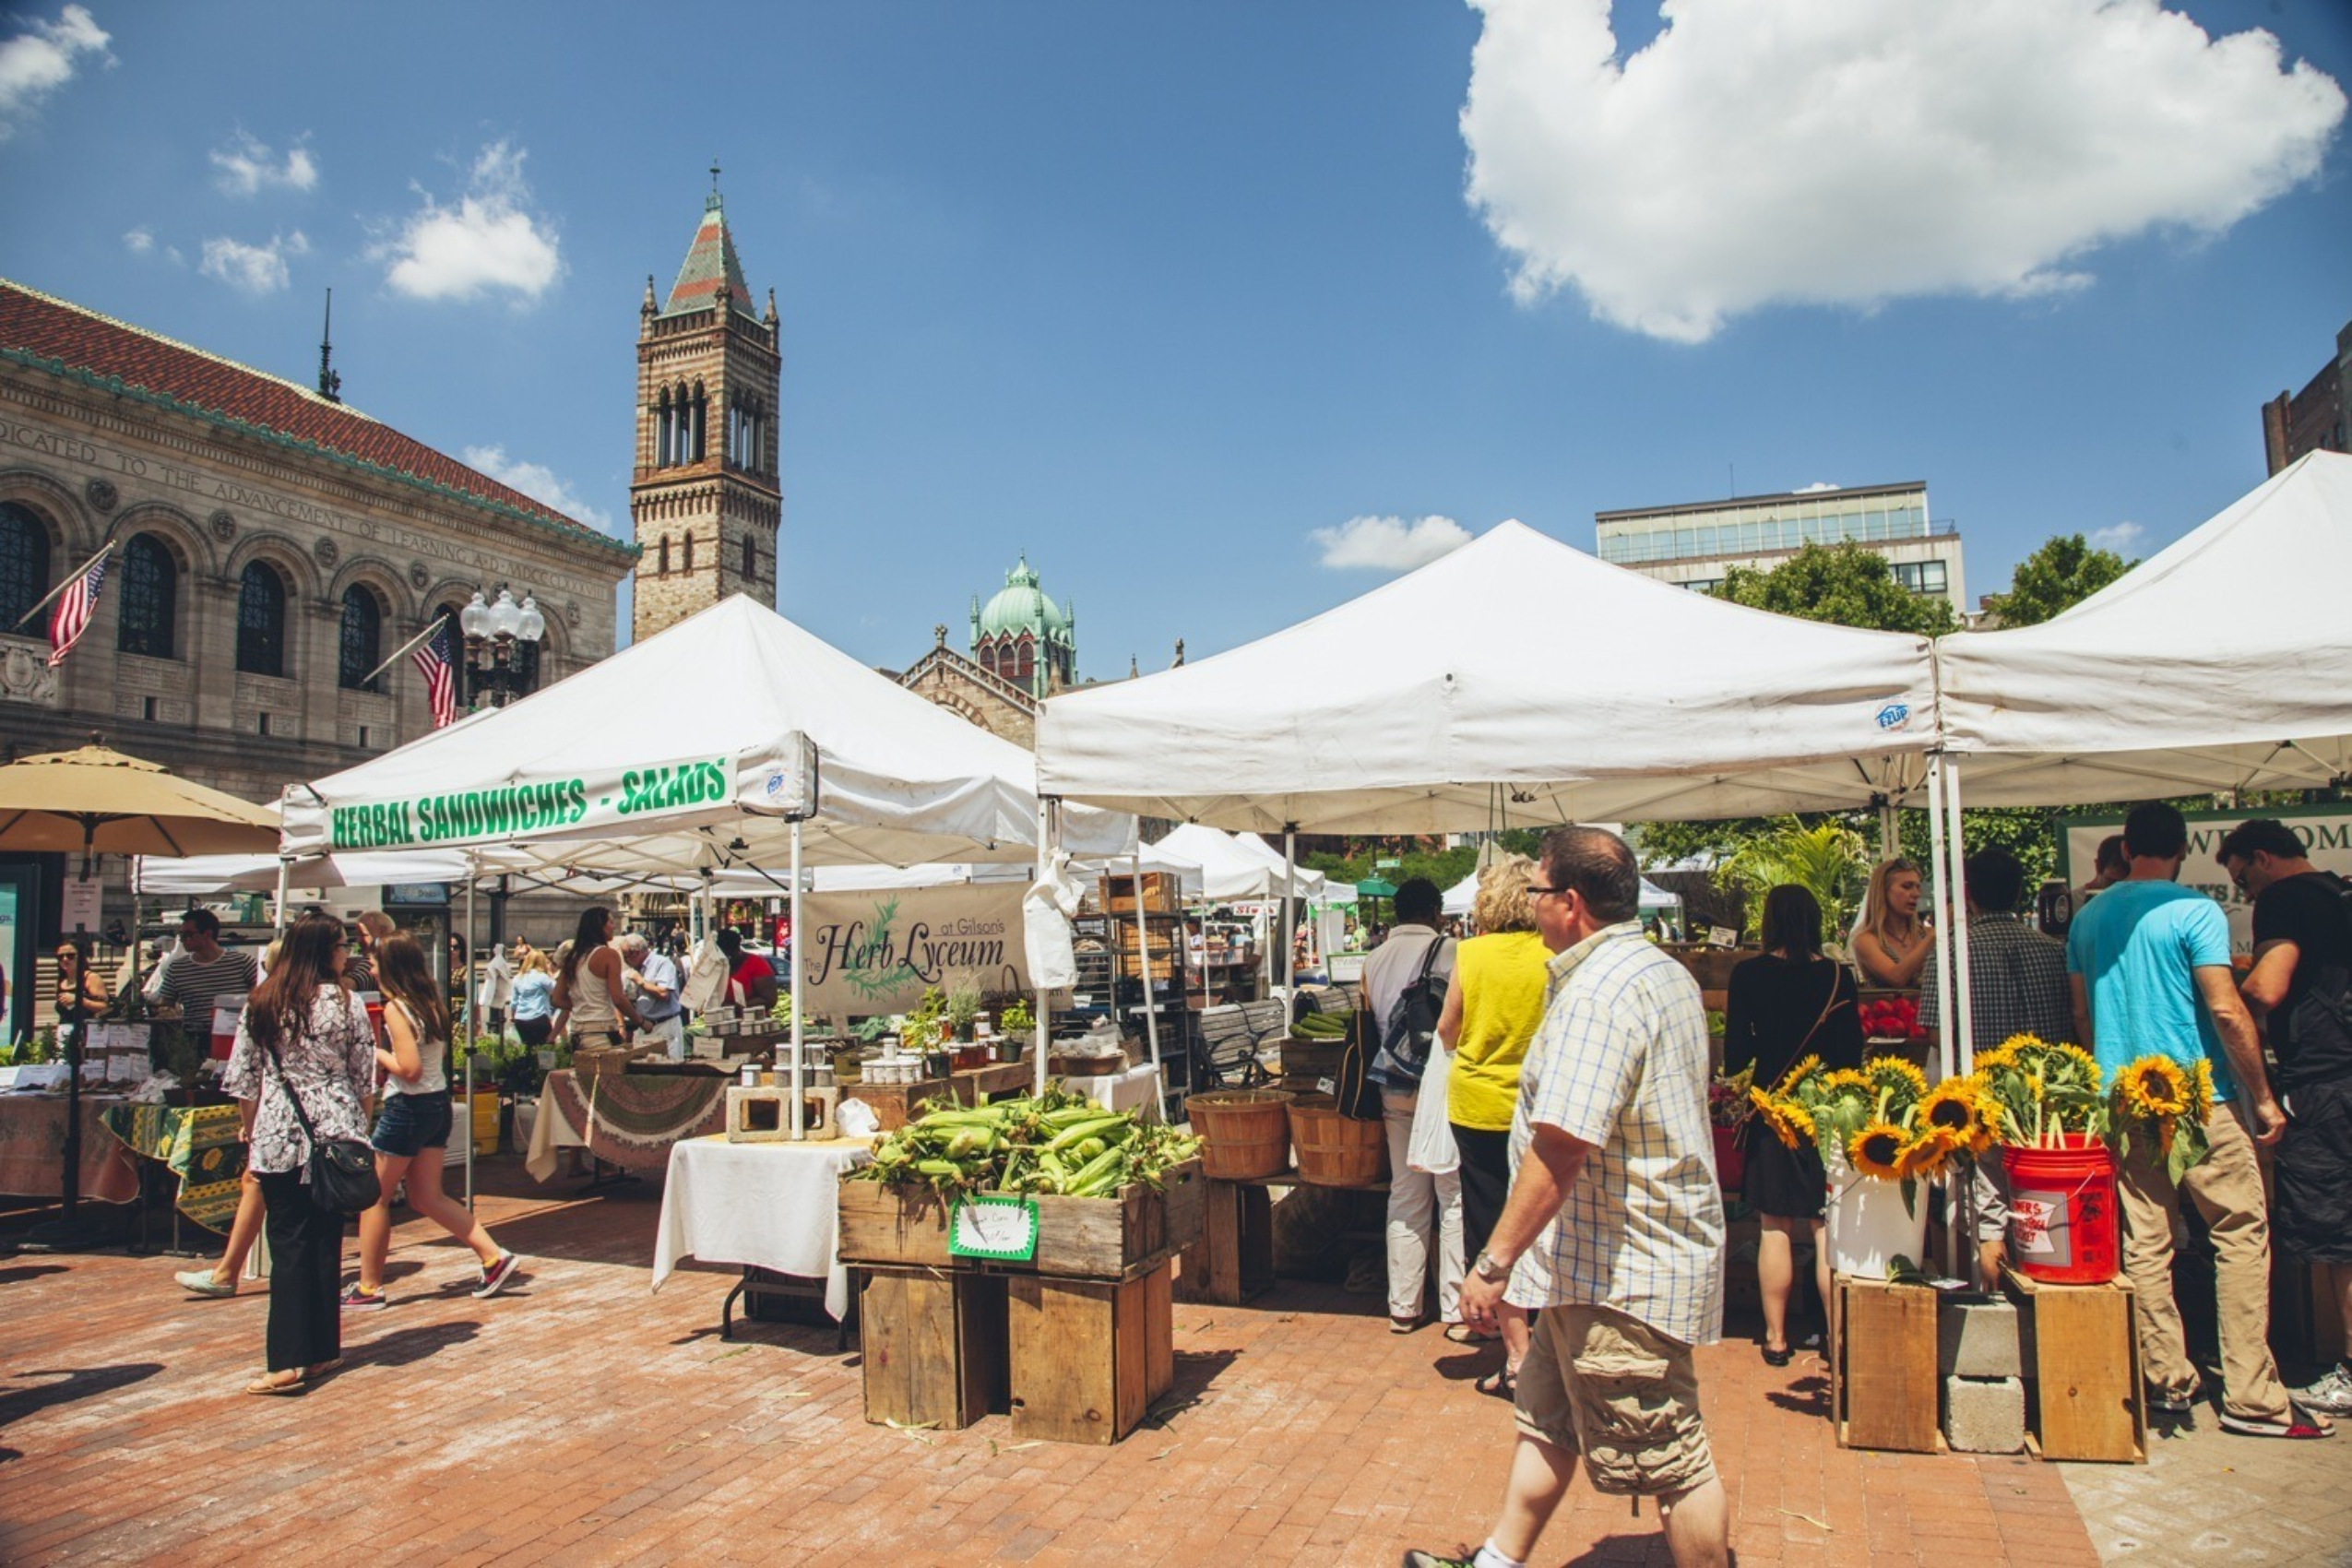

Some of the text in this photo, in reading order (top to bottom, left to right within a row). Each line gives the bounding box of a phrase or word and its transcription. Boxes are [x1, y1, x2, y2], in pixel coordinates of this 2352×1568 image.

[117, 453, 147, 476] TO
[160, 466, 202, 493] THE
[215, 483, 348, 530] ADVANCEMENT
[359, 521, 381, 539] OF
[392, 529, 468, 561] LEARNING
[333, 801, 414, 849] HERBAL
[417, 778, 587, 841] SANDWICHES
[617, 757, 727, 814] SALADS
[803, 921, 1004, 986] The Herb Lyceum
[941, 919, 1005, 935] at Gilson's
